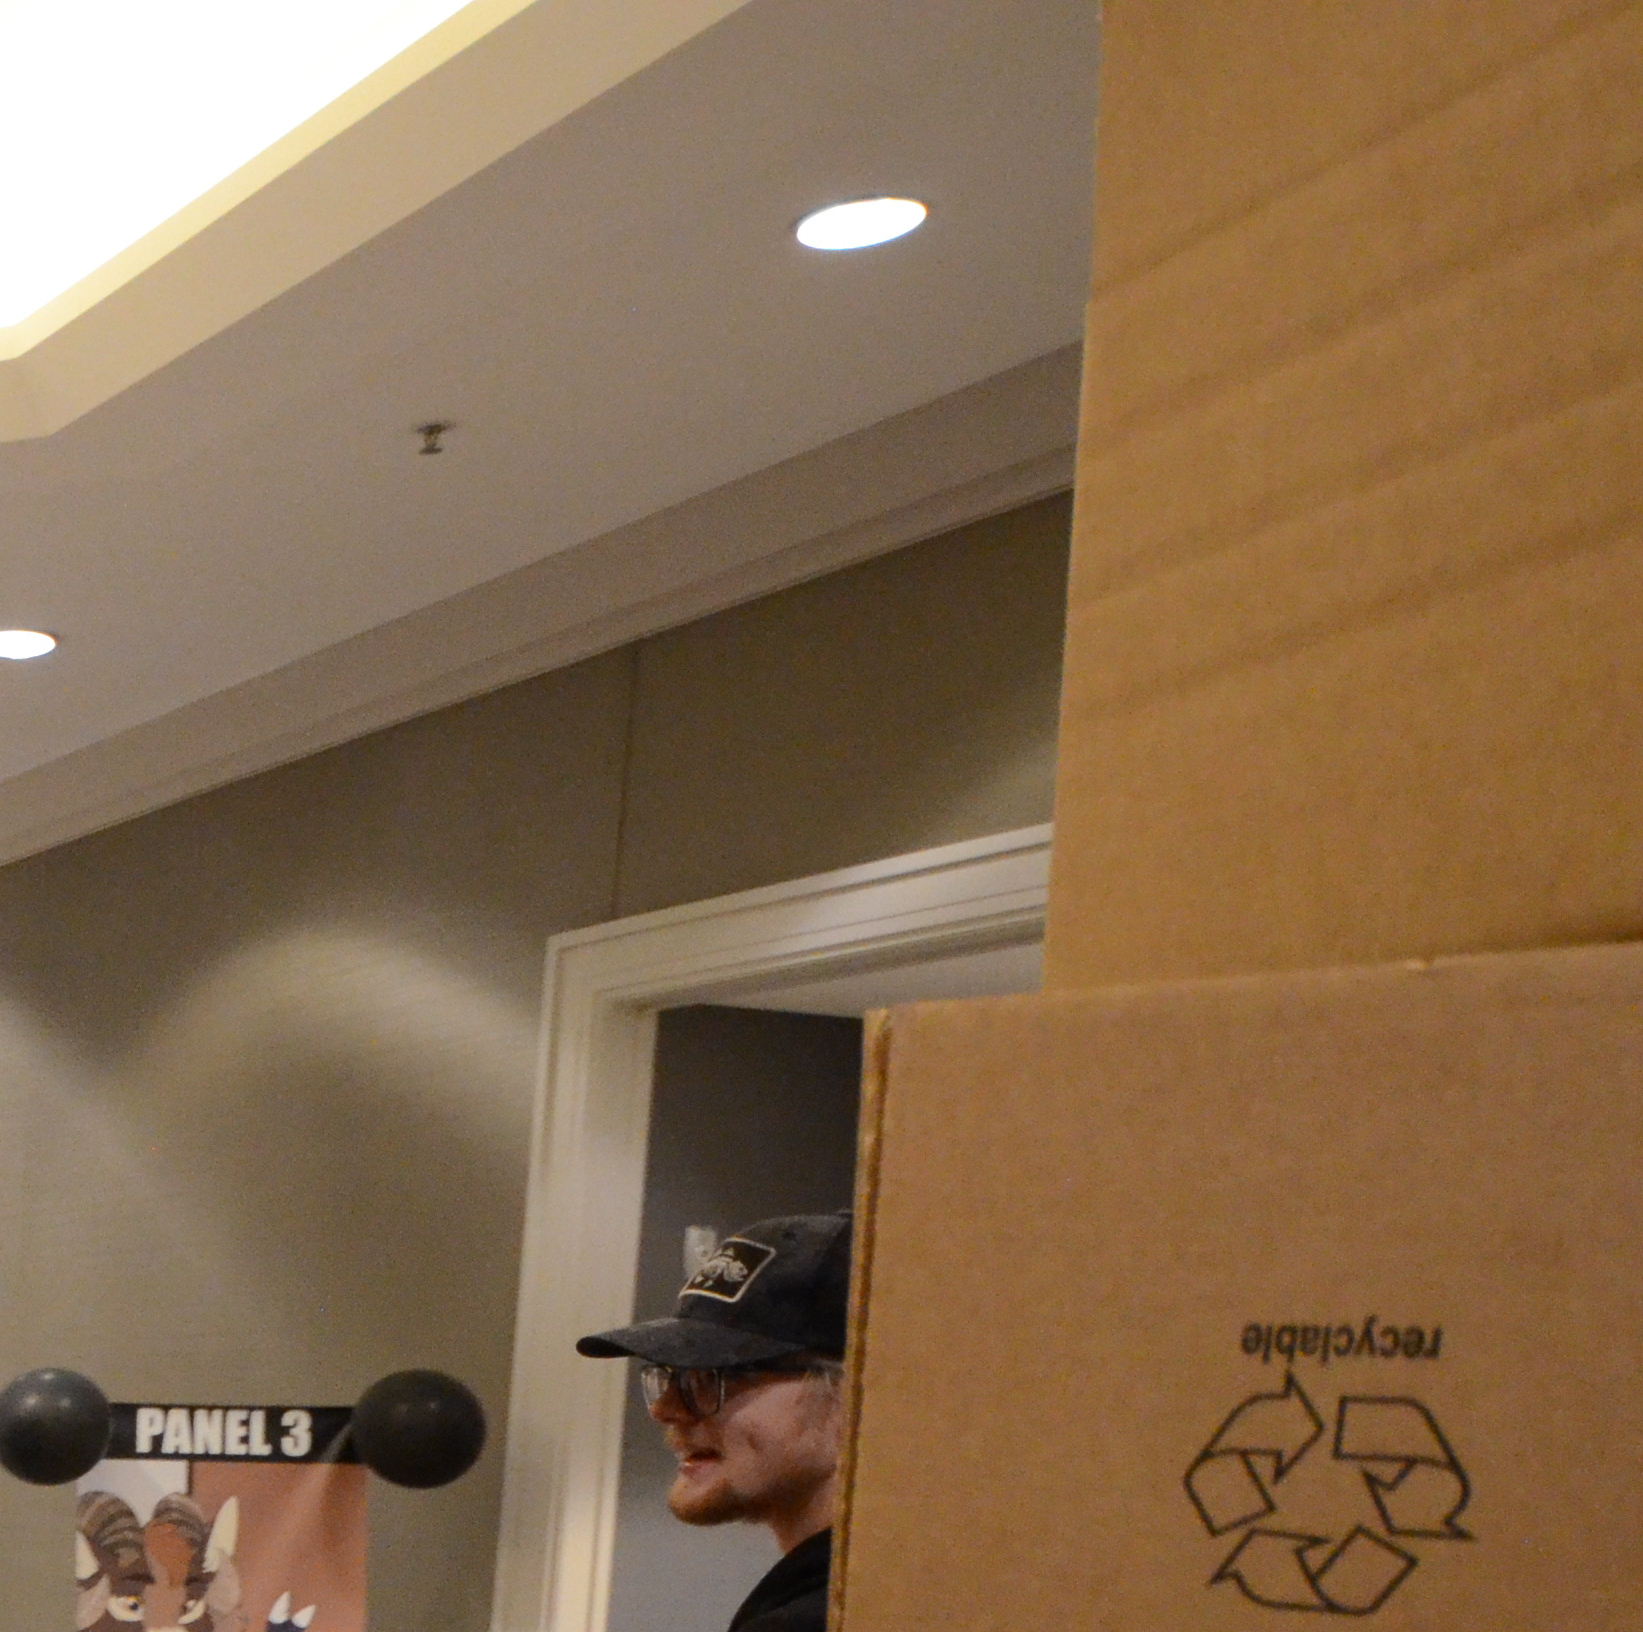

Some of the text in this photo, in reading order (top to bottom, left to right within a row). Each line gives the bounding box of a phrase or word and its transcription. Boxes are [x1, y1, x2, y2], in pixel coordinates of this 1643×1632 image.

[1240, 1316, 1444, 1367] recyclable
[135, 1406, 313, 1457] PANEL 3
